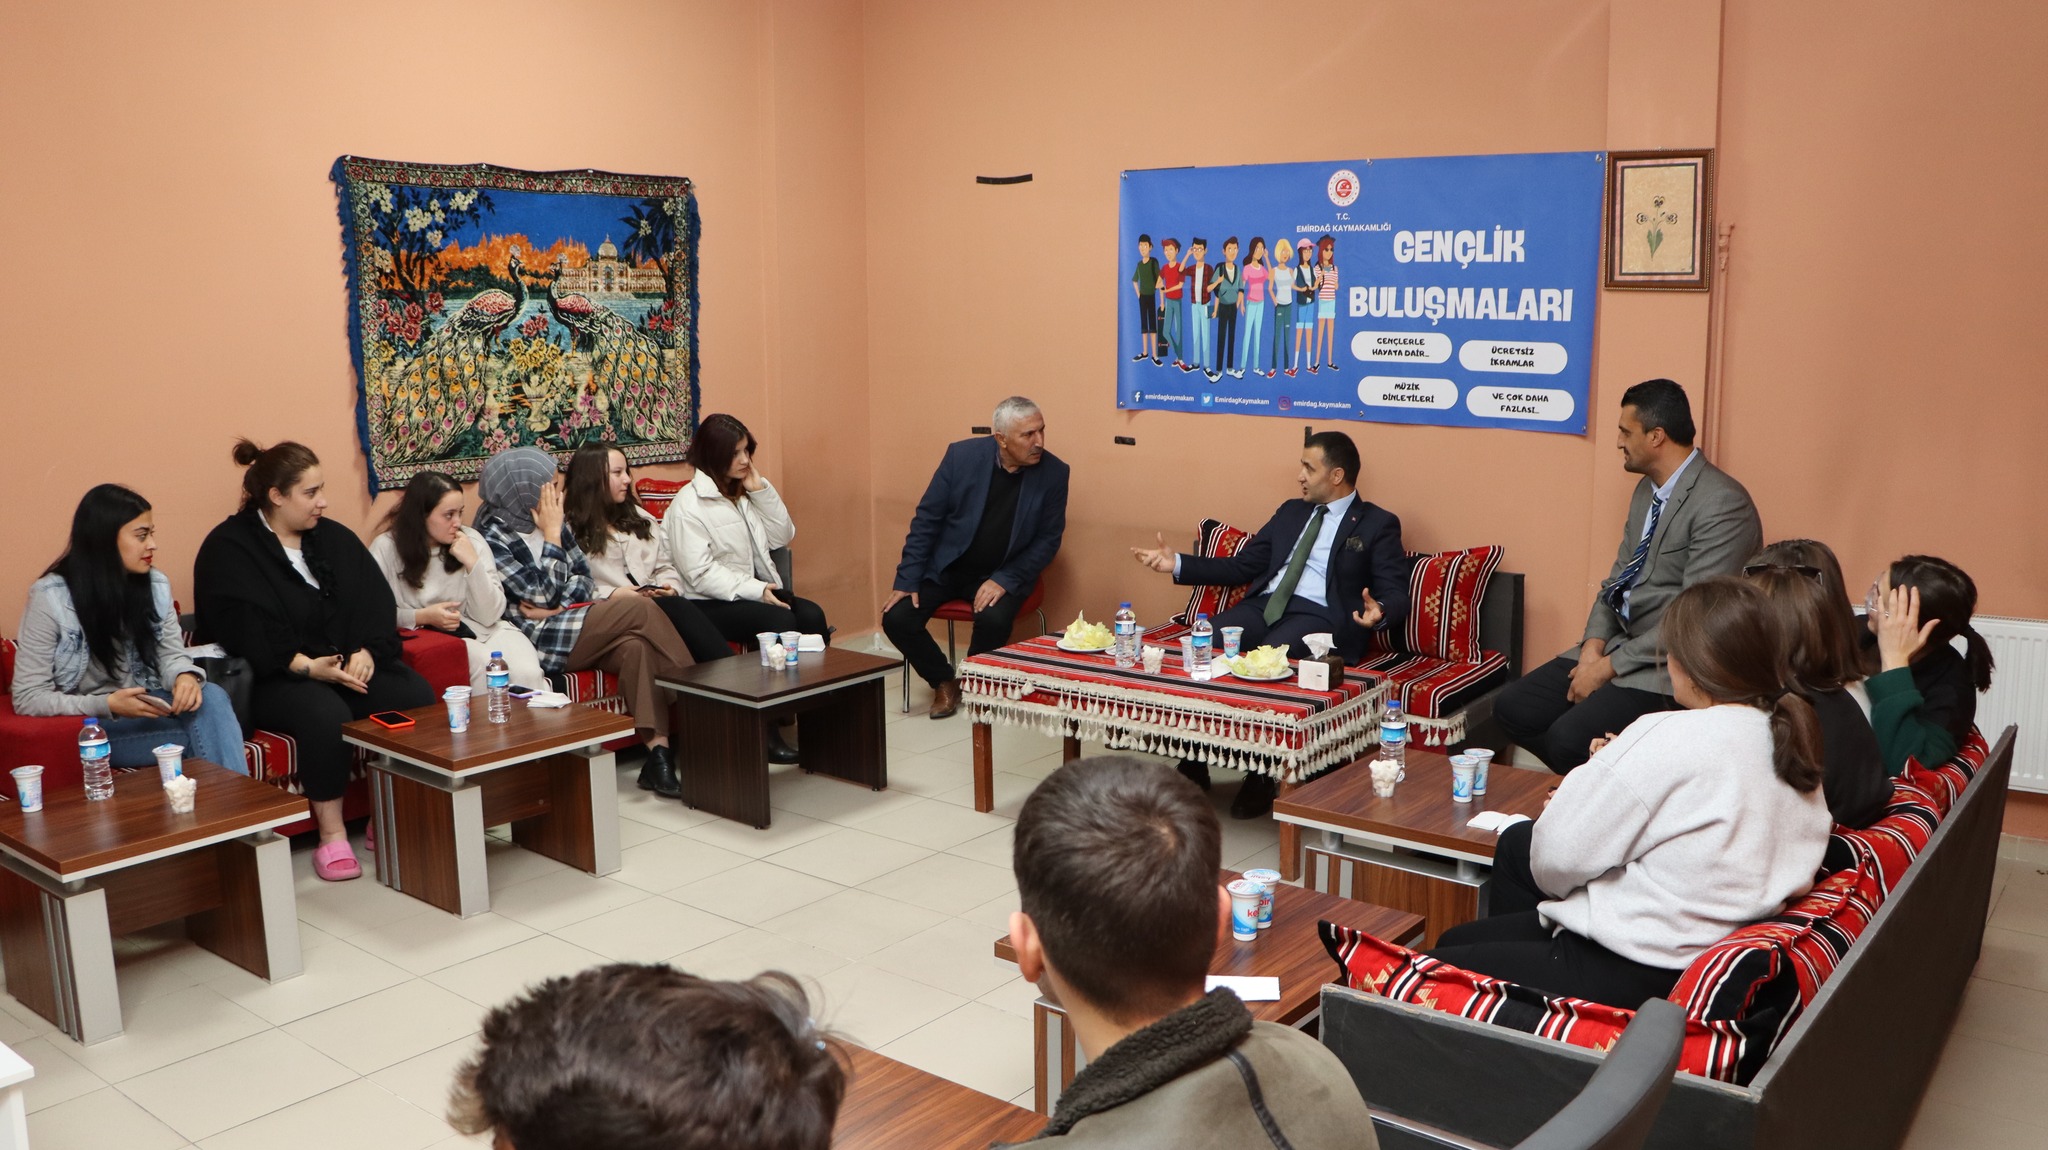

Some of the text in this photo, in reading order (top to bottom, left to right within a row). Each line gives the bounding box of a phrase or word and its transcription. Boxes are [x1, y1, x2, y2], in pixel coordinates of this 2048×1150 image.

[1336, 213, 1350, 221] T.C.
[1296, 222, 1392, 233] EMİRDAĞ KAYMAKAMLIĞI
[1393, 225, 1525, 269] GENÇLİK
[1349, 286, 1574, 326] BULUŞMALARI
[1377, 337, 1425, 346] GENÇLERLE
[1372, 348, 1403, 357] HAYATA
[1491, 346, 1535, 356] ÜCRETSİZ
[1490, 357, 1535, 368] İKRAMLAR
[1394, 382, 1420, 391] MÜZİK
[1145, 393, 1195, 402] emirdagkaymakam
[1215, 396, 1270, 406] EmirdagKaymakam
[1382, 393, 1435, 403] DİNLETİLERİ
[1506, 394, 1523, 402] ÇOK
[1525, 395, 1549, 403] DAHA
[1293, 400, 1352, 409] emirdag.kaymakam
